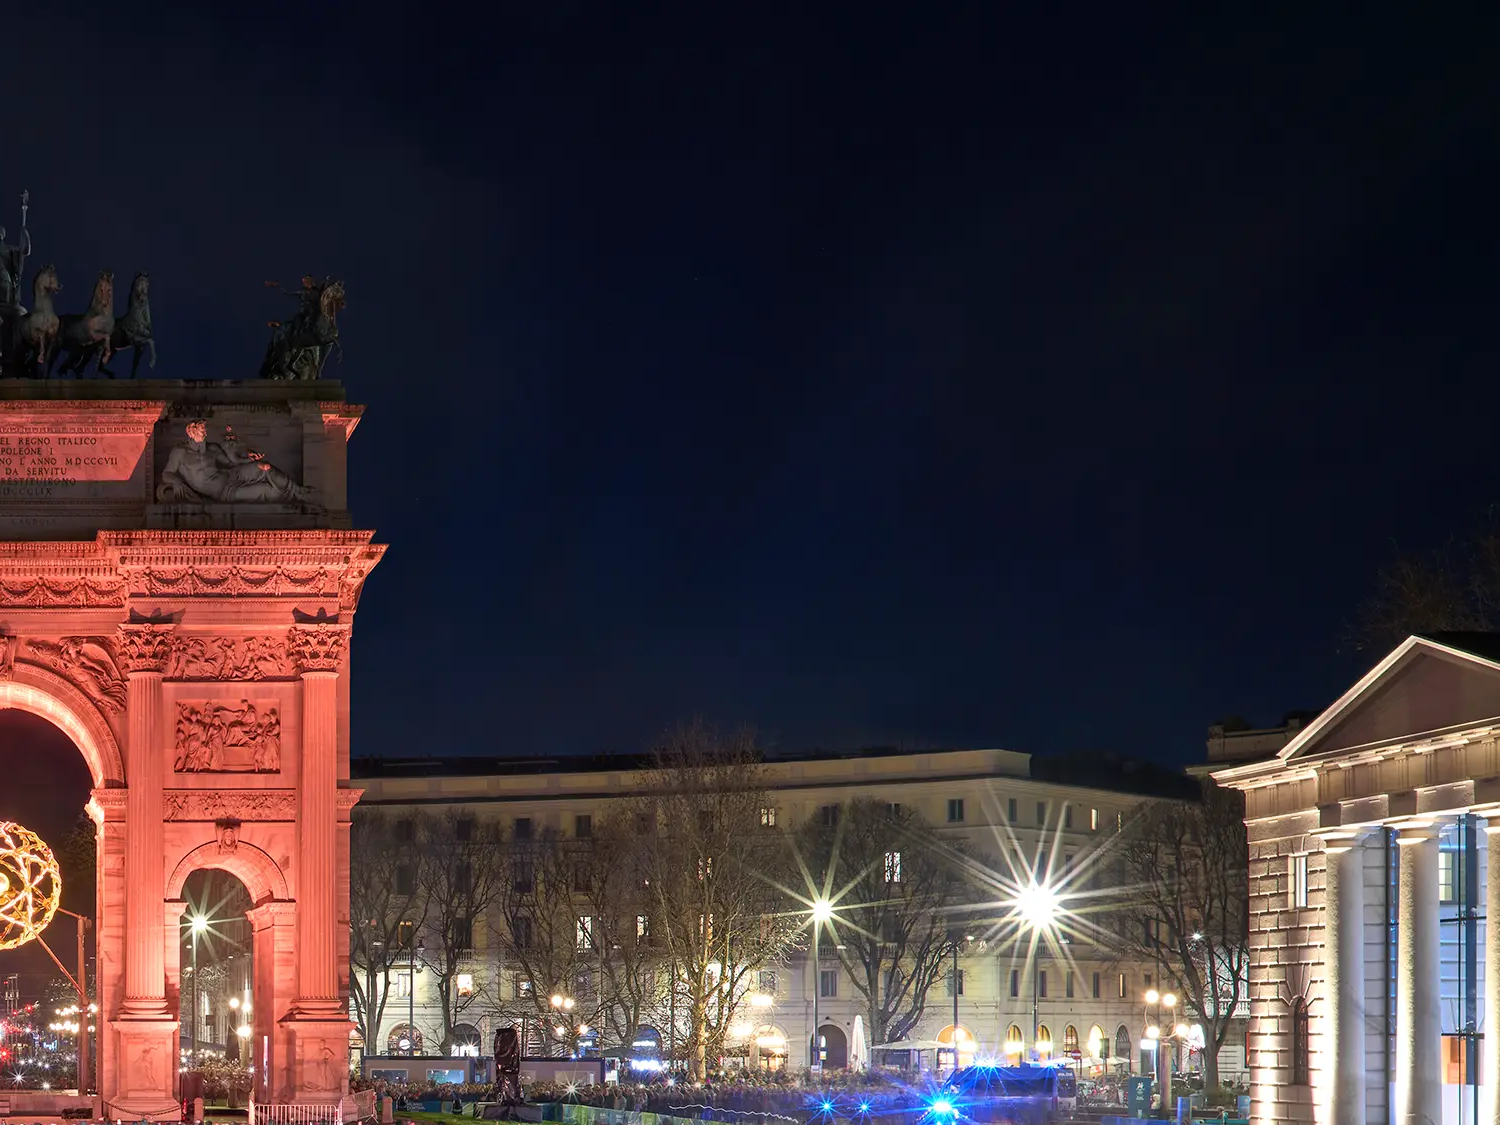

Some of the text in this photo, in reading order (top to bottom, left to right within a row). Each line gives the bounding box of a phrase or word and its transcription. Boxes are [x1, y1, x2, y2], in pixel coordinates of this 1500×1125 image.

[18, 437, 51, 446] REGNO
[57, 437, 97, 446] ITALICO
[49, 447, 54, 456] I
[5, 467, 19, 476] DA
[0, 477, 77, 486] RESTITUIRONO
